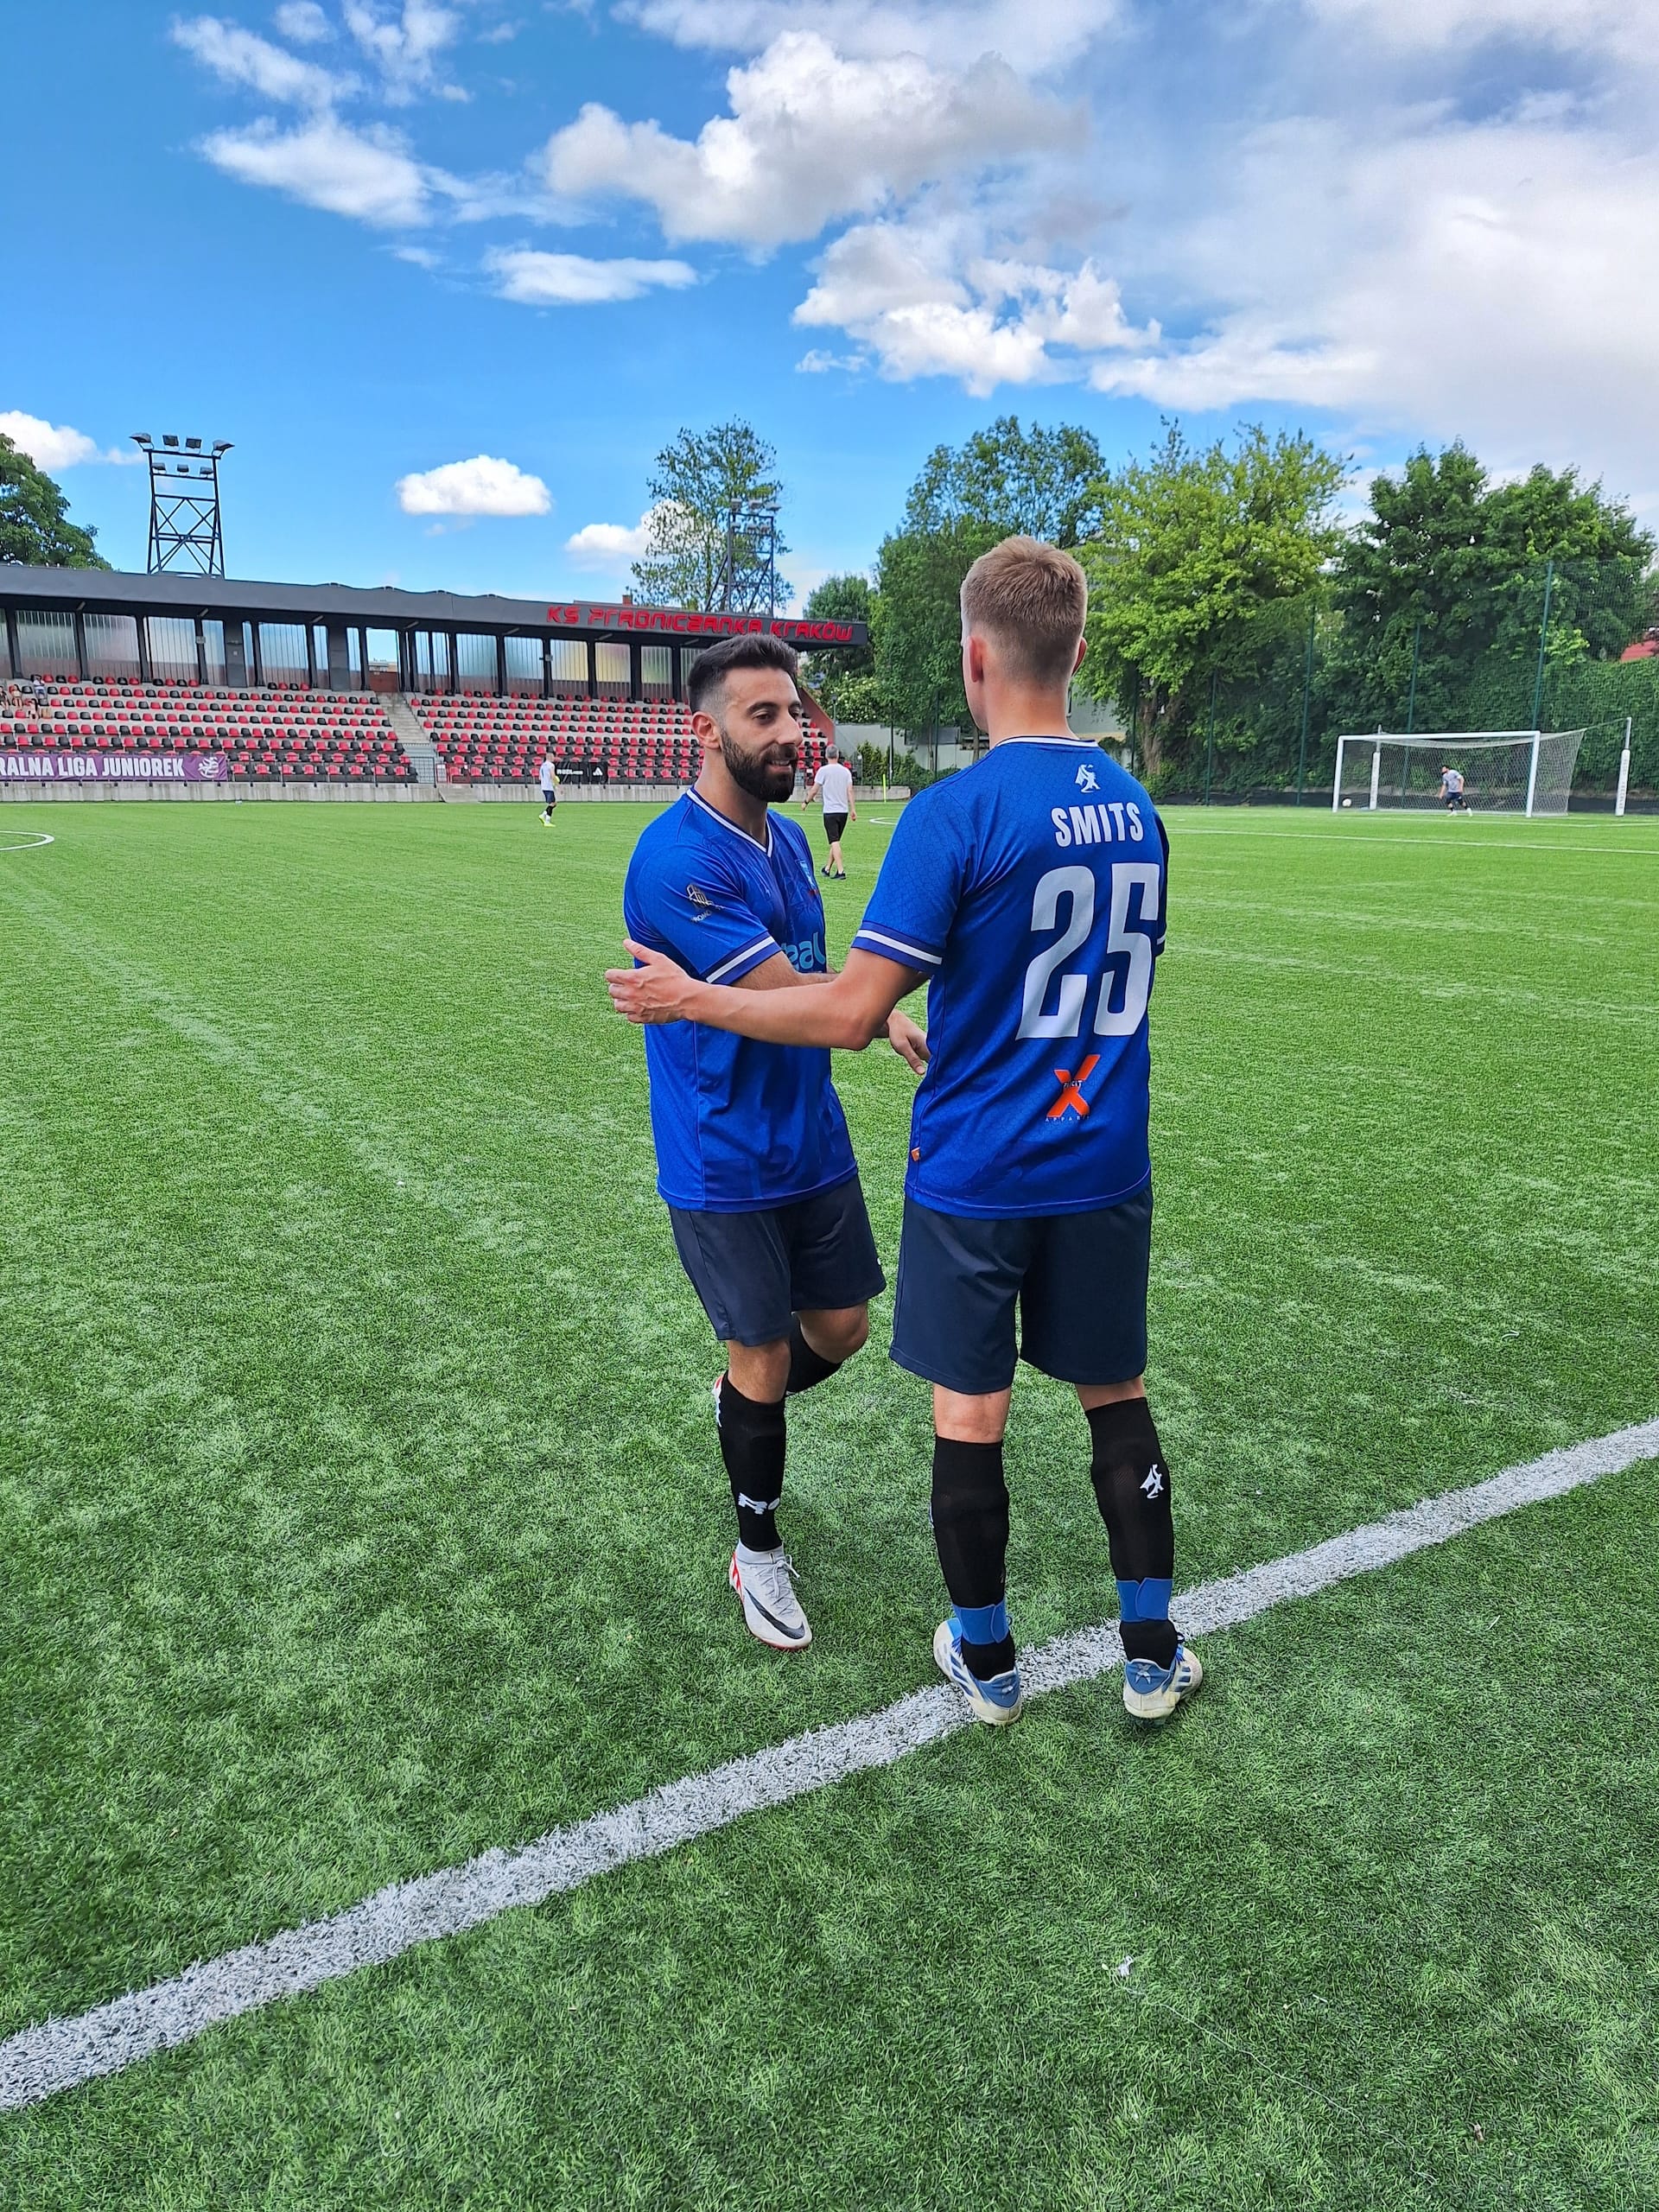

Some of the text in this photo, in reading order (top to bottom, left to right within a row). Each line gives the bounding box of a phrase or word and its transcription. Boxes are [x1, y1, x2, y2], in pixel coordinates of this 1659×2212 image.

[547, 607, 581, 624] KS
[770, 619, 853, 642] KRAKÓW
[58, 757, 98, 777] LIGA
[102, 758, 186, 777] JUNIOREK
[1051, 802, 1144, 848] SMITS
[1015, 862, 1160, 1040] 25
